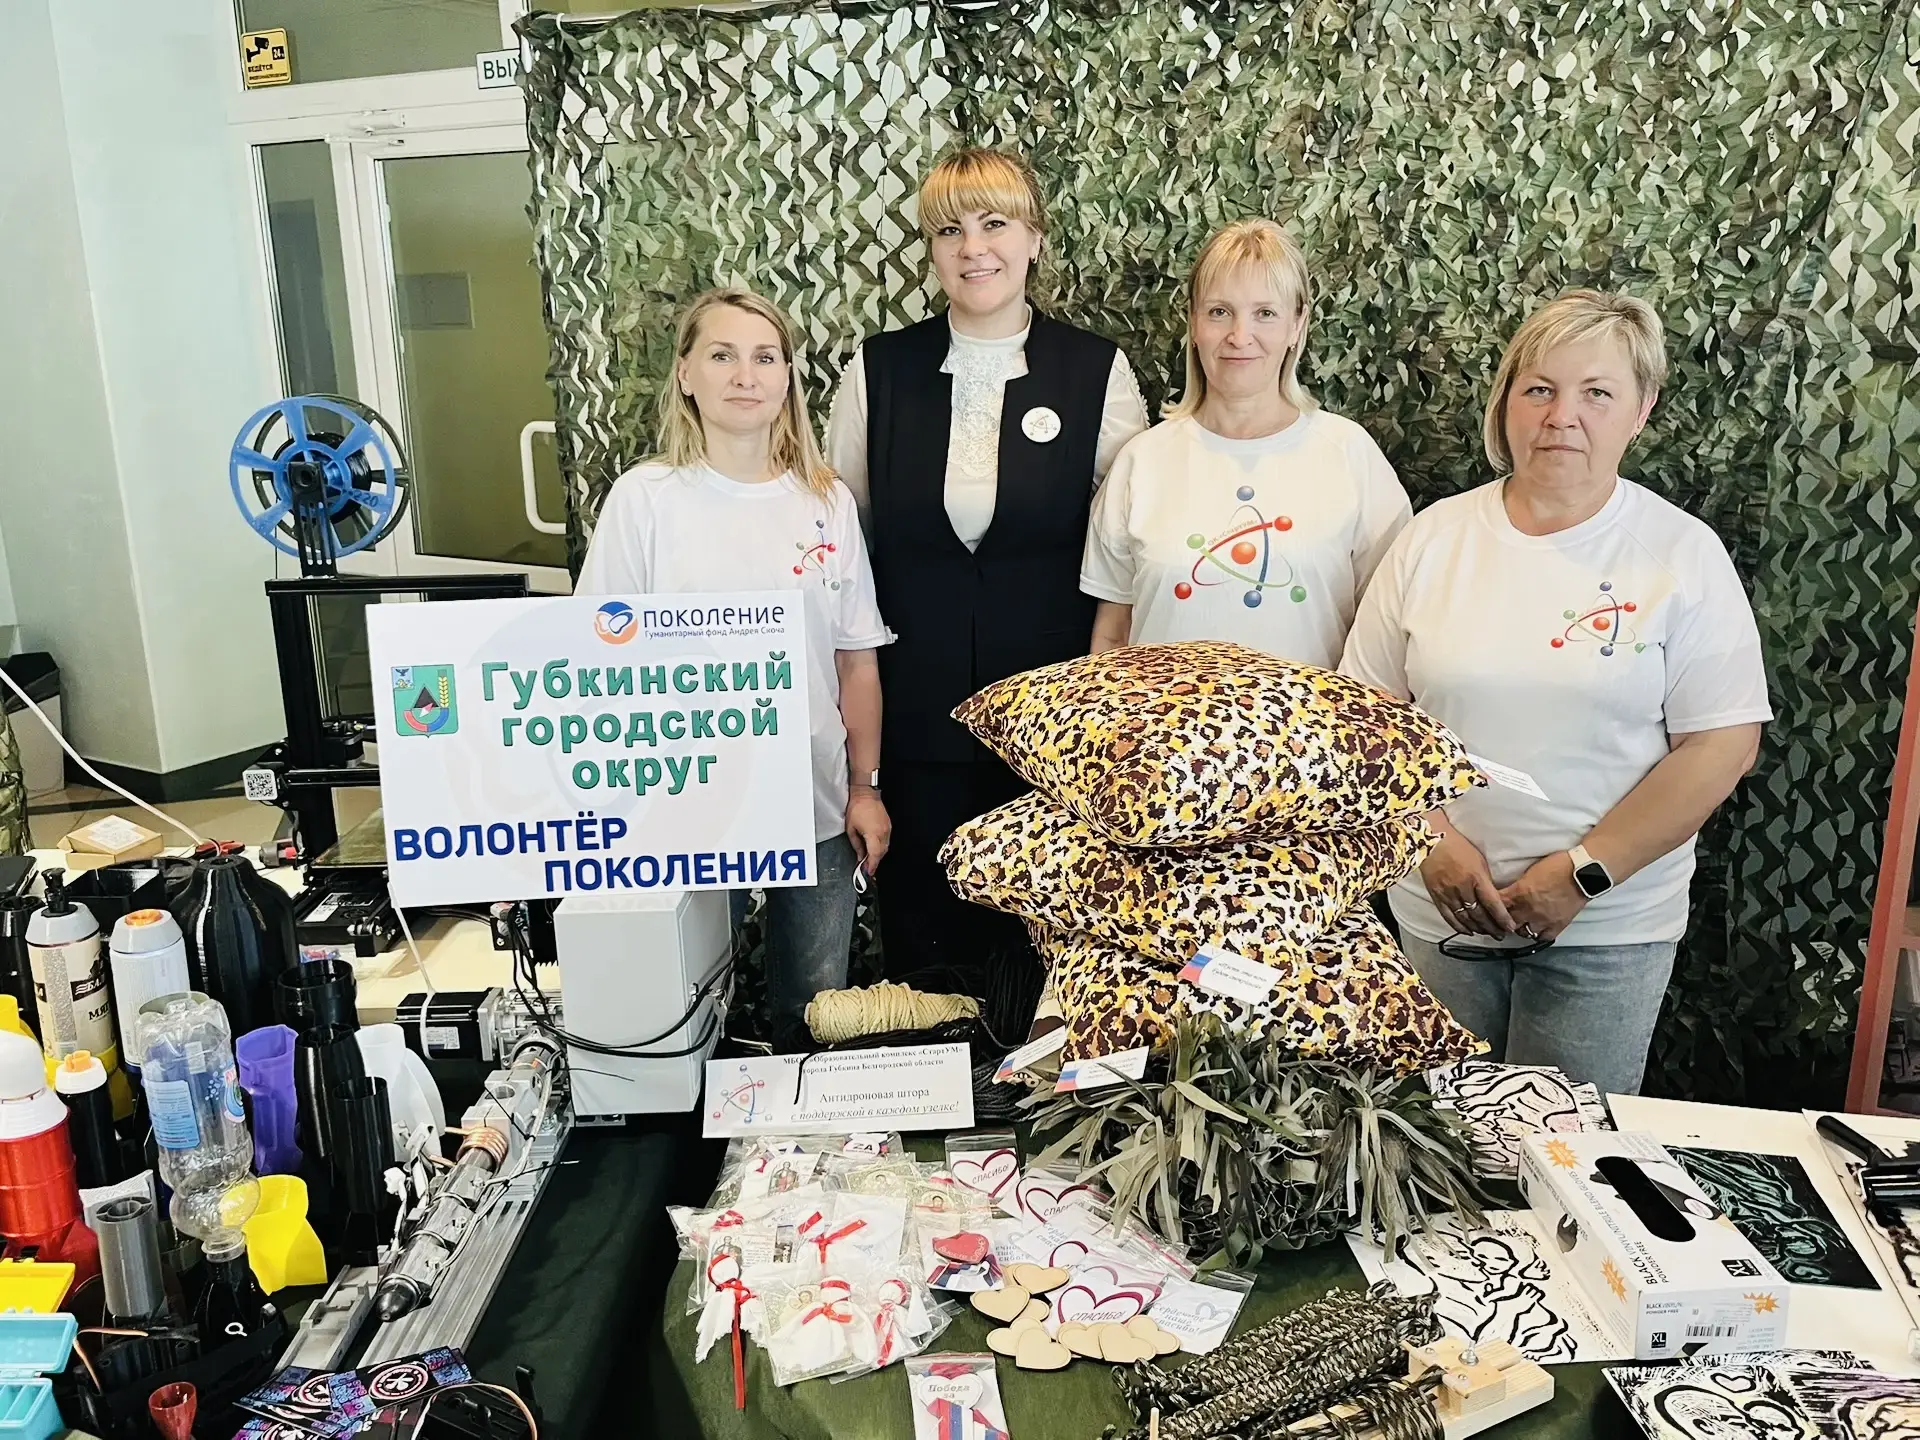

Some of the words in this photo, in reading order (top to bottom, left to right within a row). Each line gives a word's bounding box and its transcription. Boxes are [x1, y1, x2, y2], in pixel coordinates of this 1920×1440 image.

[643, 606, 785, 628] поколение
[644, 628, 703, 640] Гуманитарный
[705, 628, 727, 637] фонд
[729, 627, 758, 636] Андрея
[760, 627, 785, 635] Скоча
[481, 650, 792, 710] Губкинский
[501, 697, 778, 754] городской
[572, 754, 717, 796] округ
[393, 811, 628, 862] ВОЛОНТЁР
[544, 849, 808, 892] ПОКОЛЕНИЯ
[881, 1050, 916, 1058] комплекс
[829, 1063, 860, 1072] Губкина
[862, 1060, 913, 1070] Белгородской
[914, 1059, 944, 1067] области
[819, 1091, 894, 1103] Антидроновая
[896, 1088, 930, 1100] штора
[799, 1107, 865, 1121] поддержкой
[867, 1108, 874, 1116] в
[876, 1105, 919, 1116] каждом
[922, 1101, 959, 1114] узелке!
[972, 1163, 1010, 1185] СПАСИБО!
[1567, 1170, 1588, 1192] GLOVES
[1583, 1190, 1604, 1212] BLEND
[1633, 1240, 1650, 1256] FREE
[1629, 1256, 1658, 1285] BLACK
[1644, 1255, 1670, 1283] POWDER
[1726, 1260, 1750, 1276] XL
[1069, 1310, 1127, 1321] СПАСИБО!
[1651, 1333, 1666, 1343] XL
[928, 1384, 970, 1392] Победа
